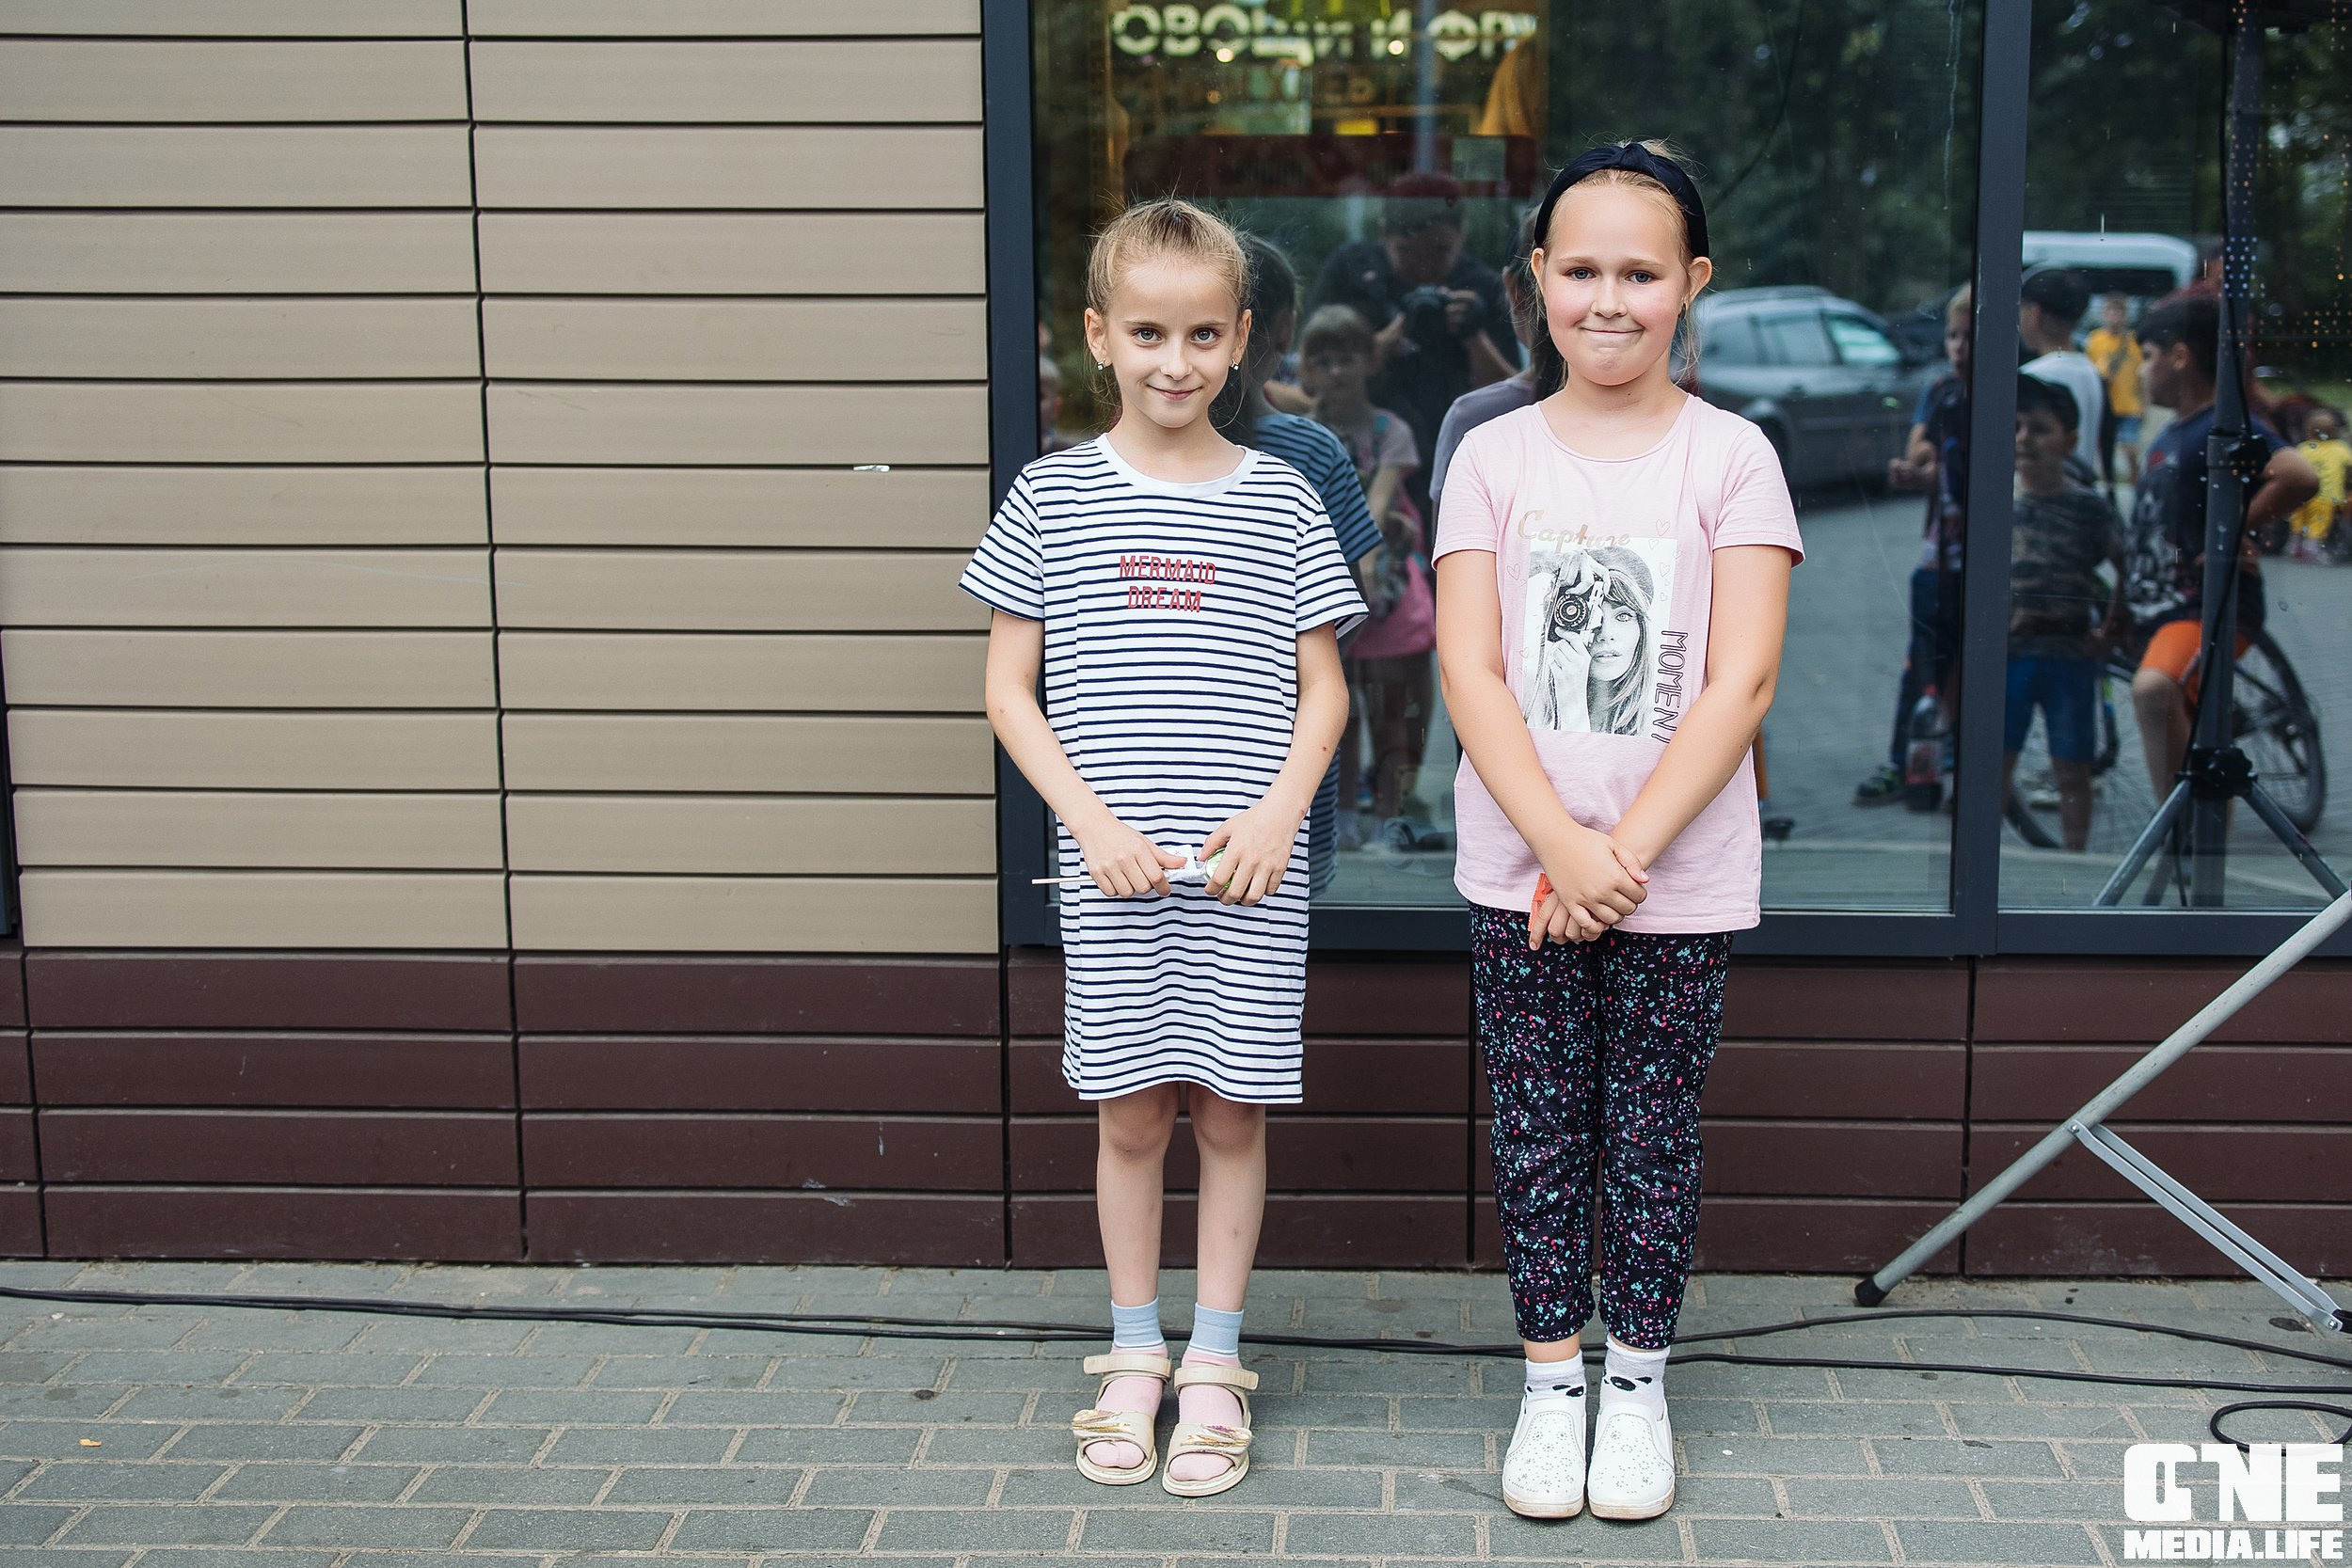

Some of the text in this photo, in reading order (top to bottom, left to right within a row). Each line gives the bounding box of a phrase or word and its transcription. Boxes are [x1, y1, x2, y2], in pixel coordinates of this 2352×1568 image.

[1518, 509, 1631, 555] Capture
[1119, 555, 1216, 585] MERMAID
[1127, 585, 1202, 613] DREAM
